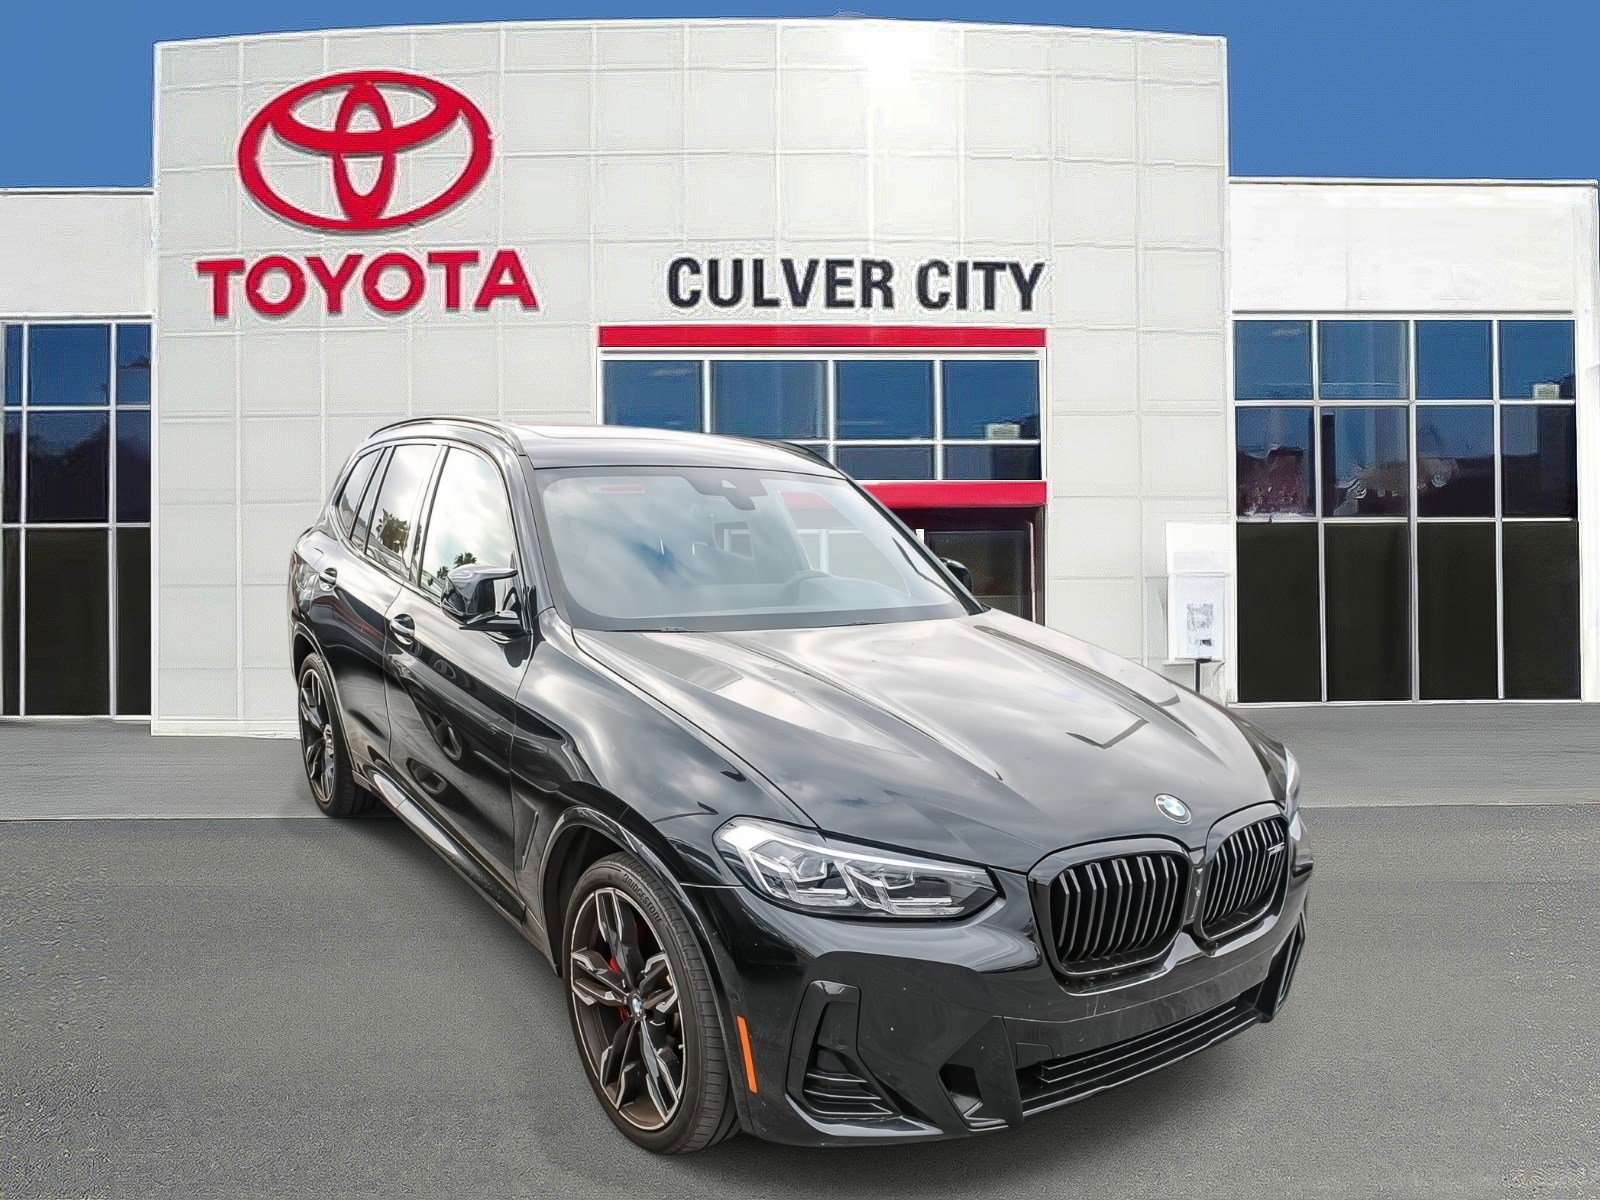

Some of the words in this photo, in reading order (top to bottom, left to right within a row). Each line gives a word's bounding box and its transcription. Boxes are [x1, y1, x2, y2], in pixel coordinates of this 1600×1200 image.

[197, 249, 537, 318] TOYOTA
[668, 257, 894, 309] CULVER
[917, 259, 1045, 312] CITY
